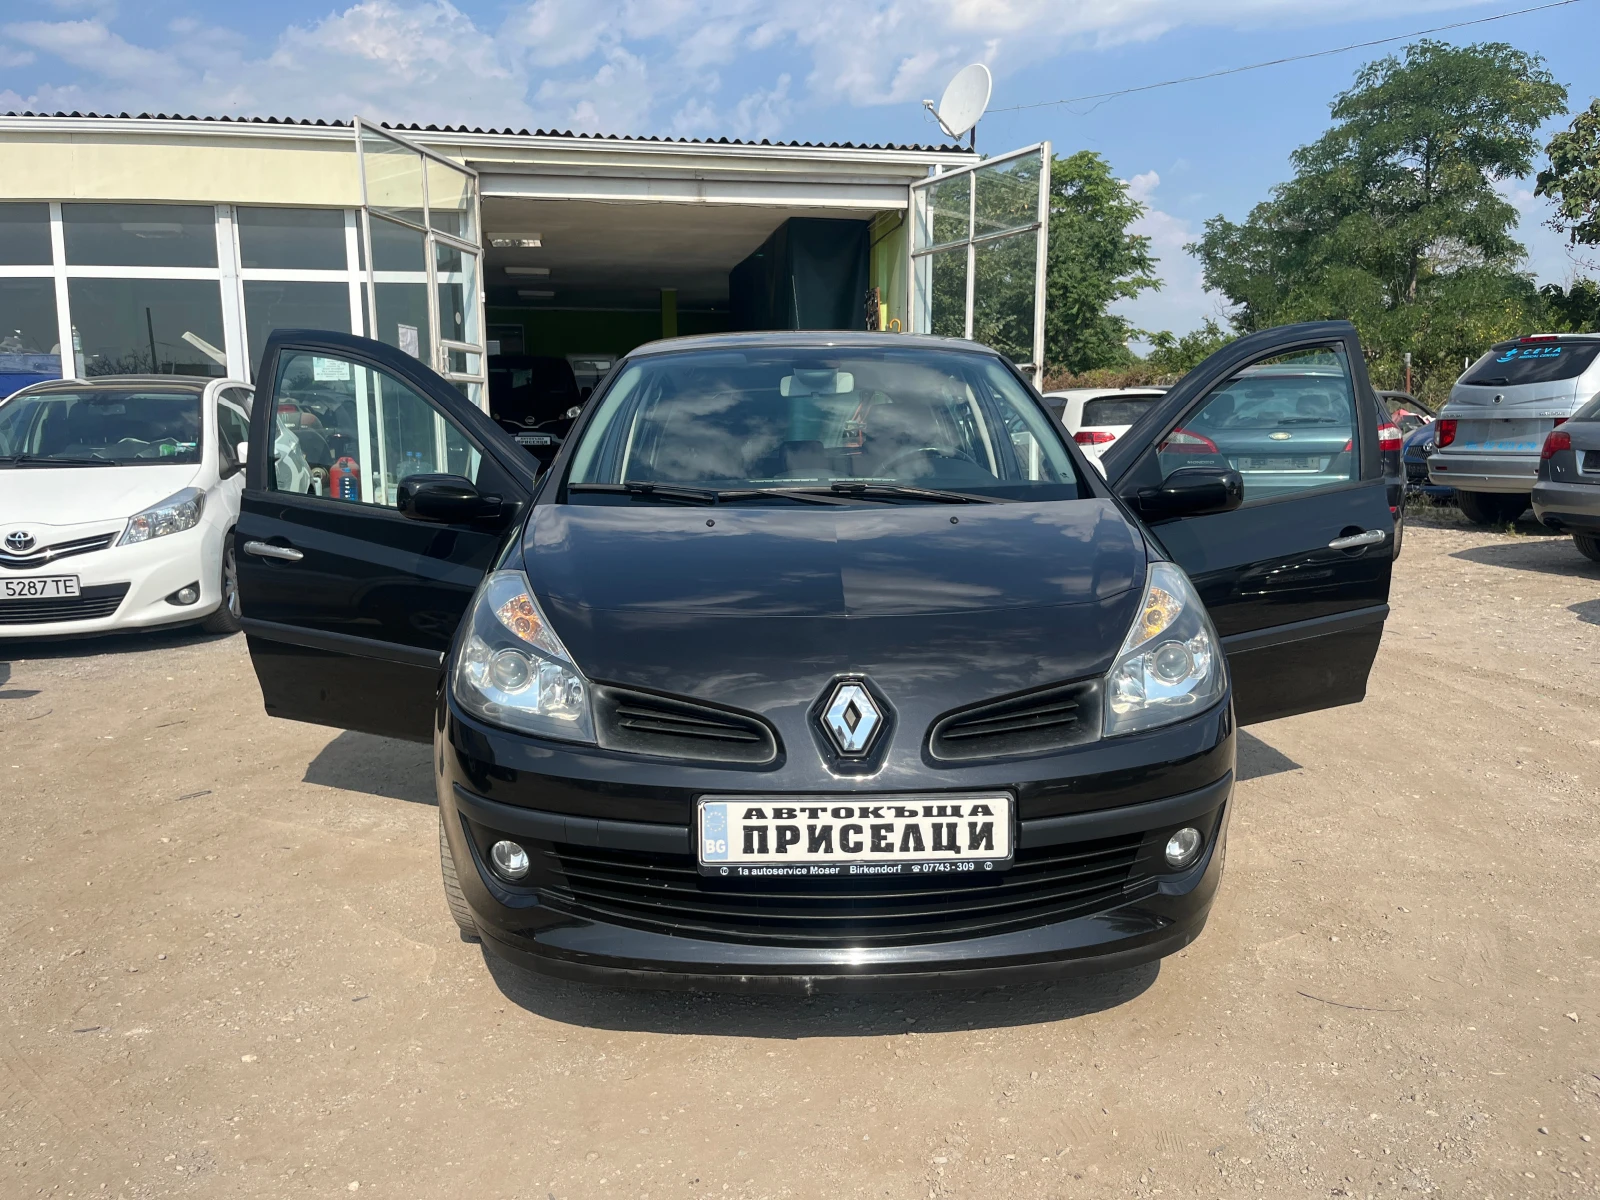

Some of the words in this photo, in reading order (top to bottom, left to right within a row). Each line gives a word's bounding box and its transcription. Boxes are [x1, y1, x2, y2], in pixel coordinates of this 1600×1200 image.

[5, 580, 48, 597] 5287
[51, 578, 76, 595] TE
[742, 804, 994, 820] АВТОКЪЩА
[742, 821, 995, 854] ПРИСЕЛЦИ
[704, 839, 726, 854] BG
[738, 867, 749, 875] 1a
[751, 866, 808, 875] autoservice
[809, 866, 840, 875] Moser
[850, 864, 902, 874] Birkendorf
